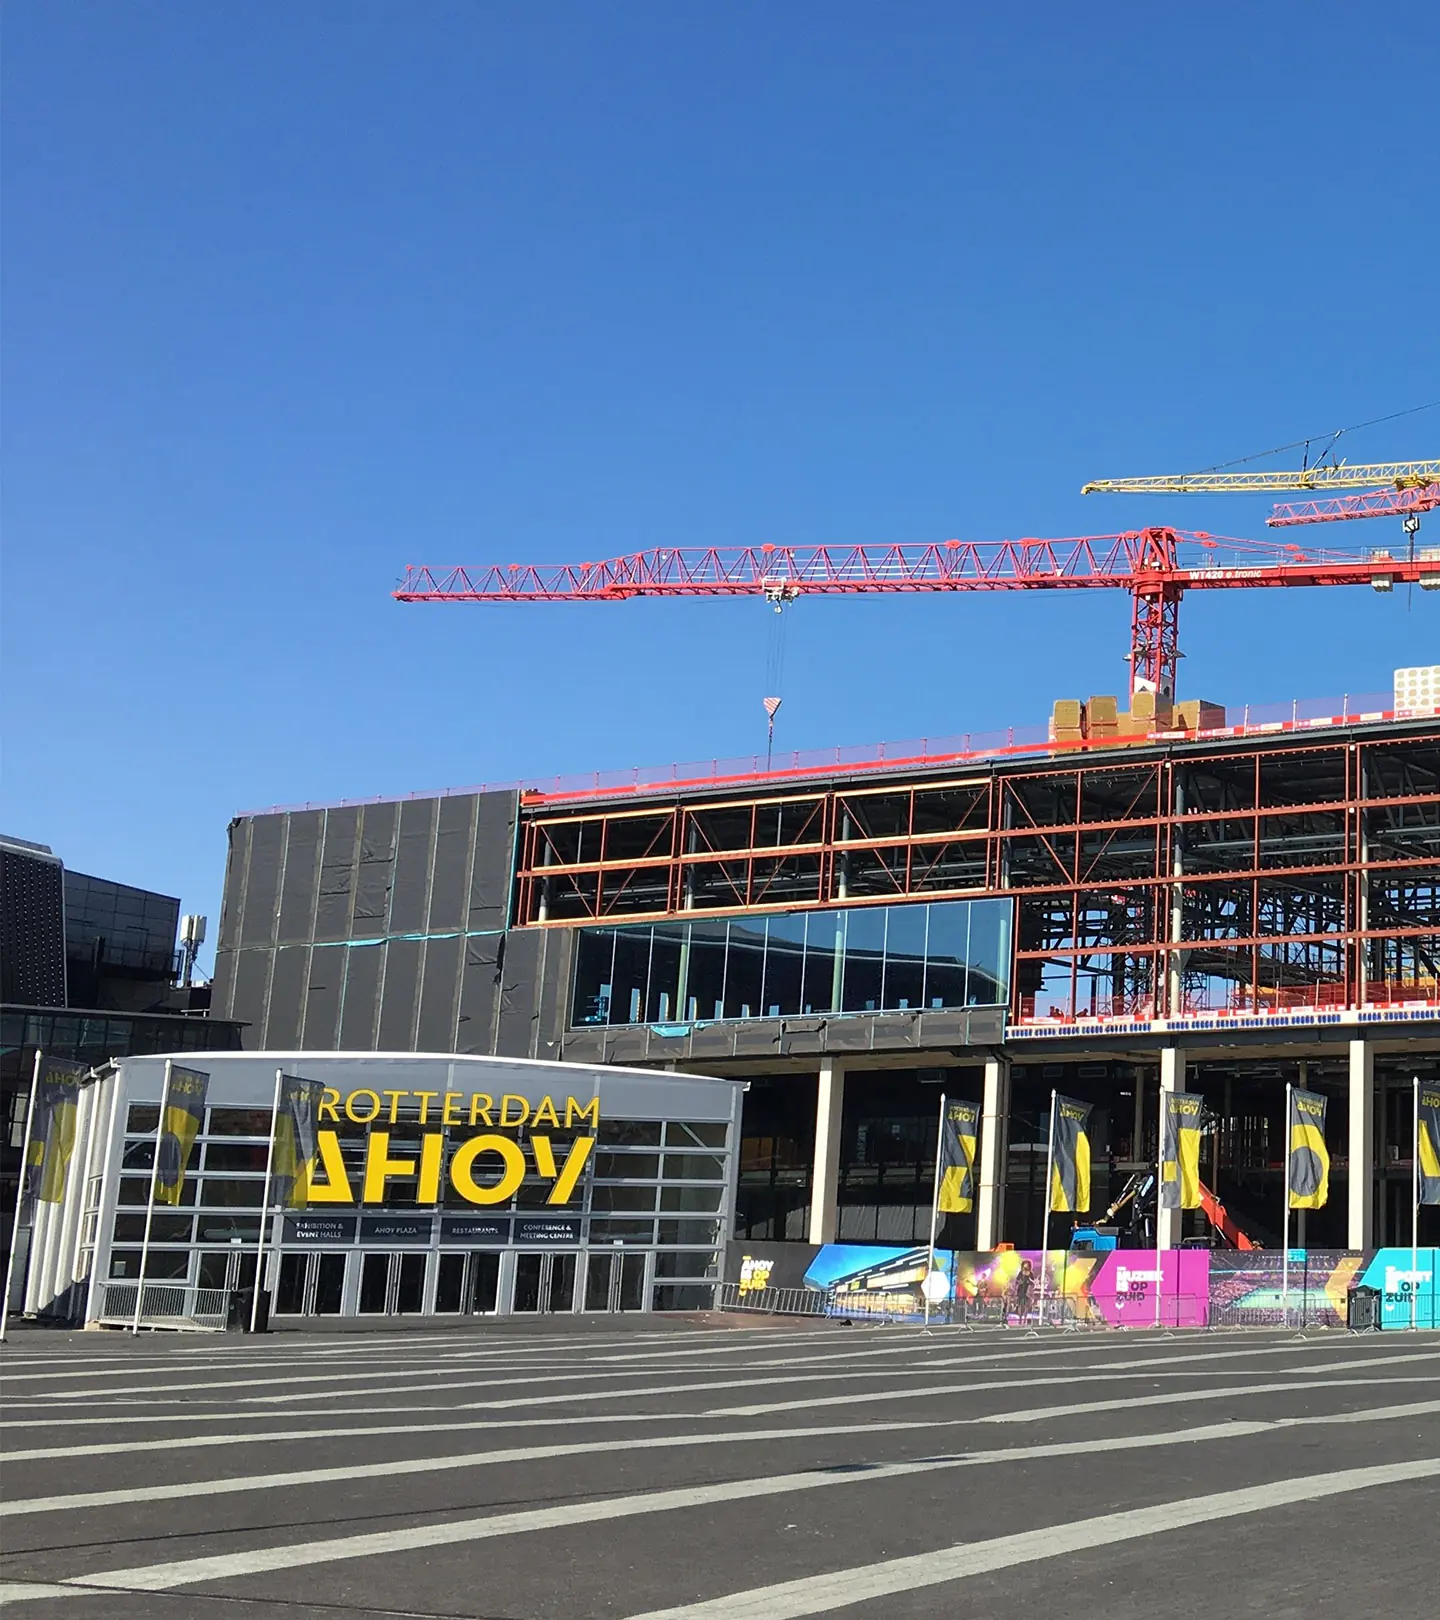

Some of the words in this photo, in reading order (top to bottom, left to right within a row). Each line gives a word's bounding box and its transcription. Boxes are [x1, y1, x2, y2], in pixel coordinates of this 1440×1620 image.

[1190, 570, 1224, 580] WT420
[318, 1087, 600, 1129] ROTTERDAM
[306, 1130, 596, 1205] AHOY
[296, 1222, 337, 1230] EXHIBITION
[741, 1259, 774, 1271] AHOY
[753, 1270, 769, 1280] OP
[740, 1280, 766, 1290] ZUID
[1130, 1281, 1148, 1291] OP
[1401, 1281, 1420, 1291] OP
